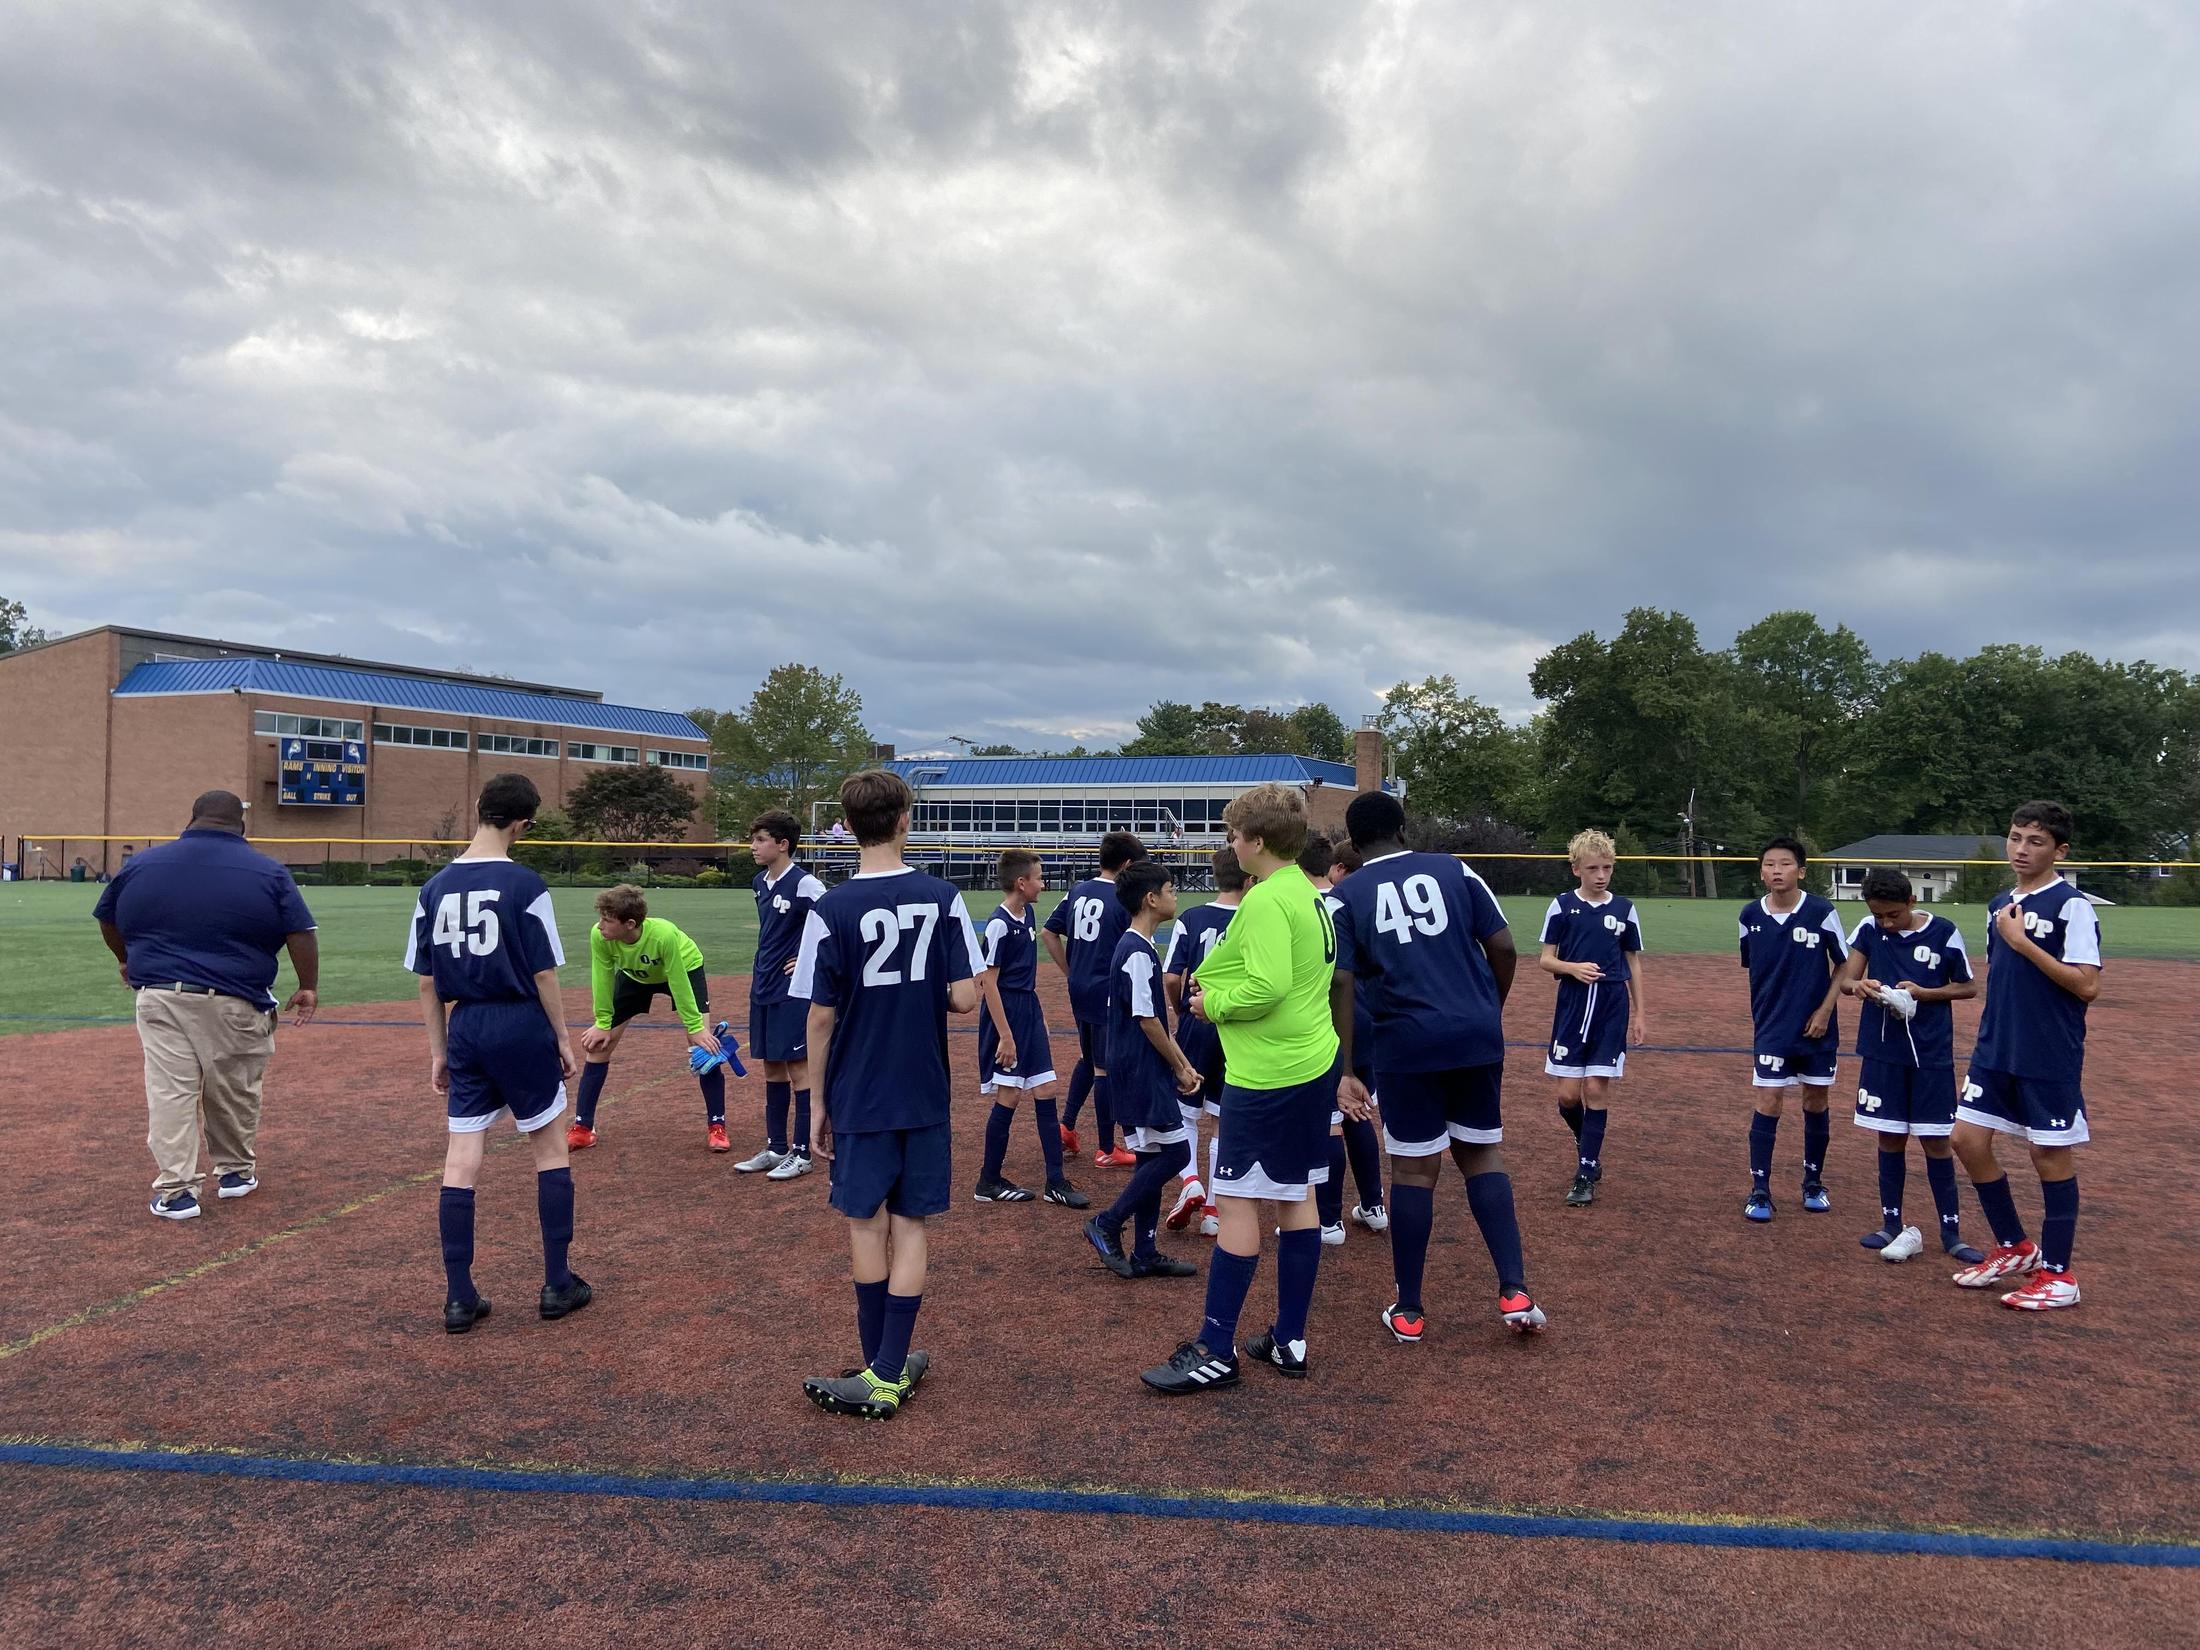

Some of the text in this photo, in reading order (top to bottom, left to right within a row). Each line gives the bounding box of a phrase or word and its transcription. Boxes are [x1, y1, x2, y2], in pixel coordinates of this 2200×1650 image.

[283, 761, 304, 771] RAMS
[313, 763, 337, 773] INNING
[341, 765, 367, 775] VISITOR
[773, 895, 791, 914] OP
[1376, 874, 1448, 944] 49
[433, 890, 500, 958] 45
[1073, 896, 1104, 942] 18
[1603, 915, 1626, 936] OP
[2024, 911, 2054, 938] OP
[860, 903, 939, 987] 27
[1793, 927, 1820, 948] OP
[1913, 945, 1941, 970] OP
[1858, 1088, 1882, 1112] OP
